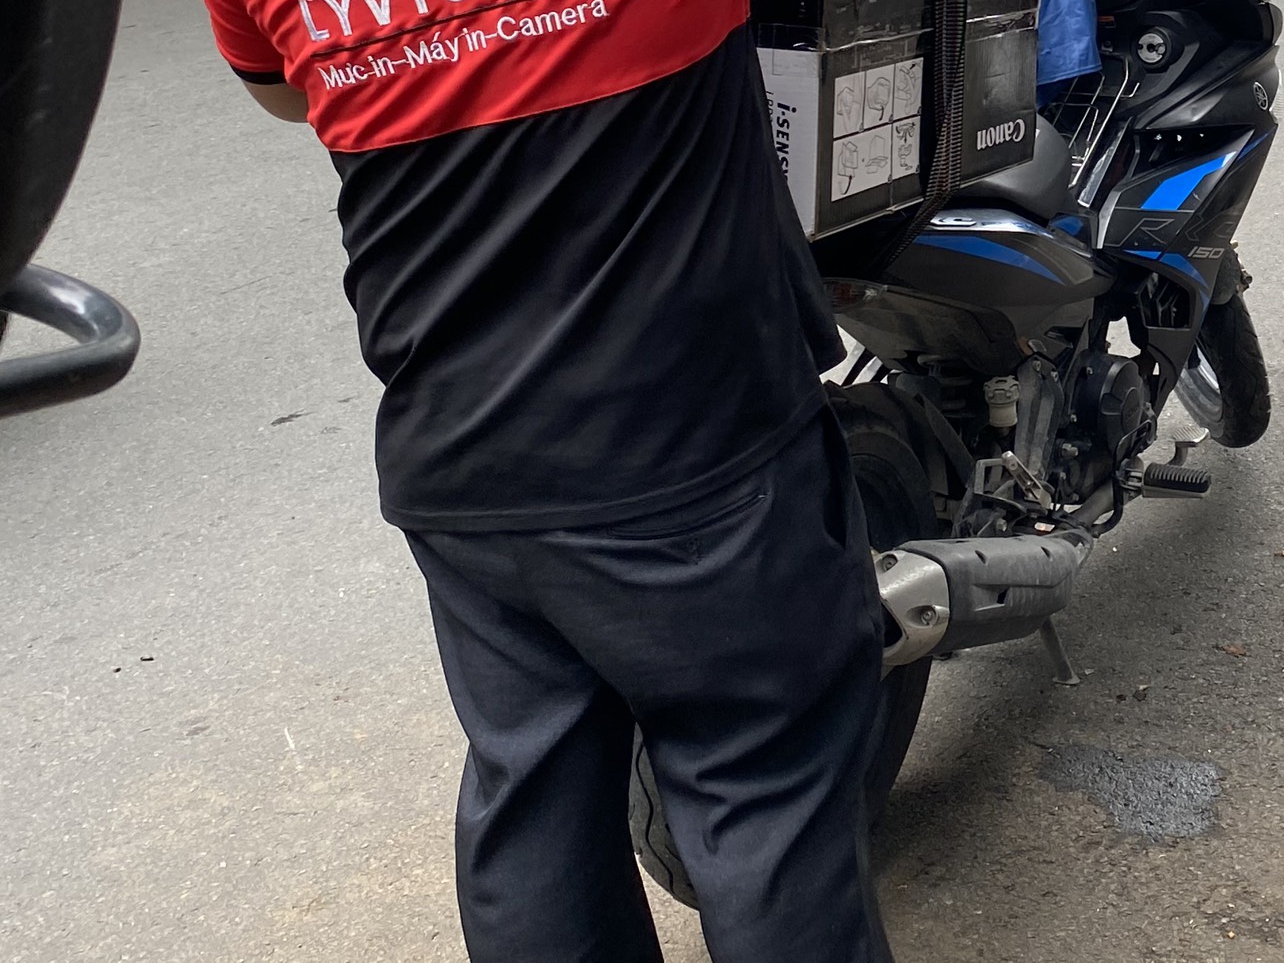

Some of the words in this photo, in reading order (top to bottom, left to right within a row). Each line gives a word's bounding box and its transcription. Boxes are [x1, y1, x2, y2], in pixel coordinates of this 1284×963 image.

[776, 102, 799, 182] i-SENS
[976, 118, 1027, 152] Canon
[1187, 245, 1225, 259] 150
